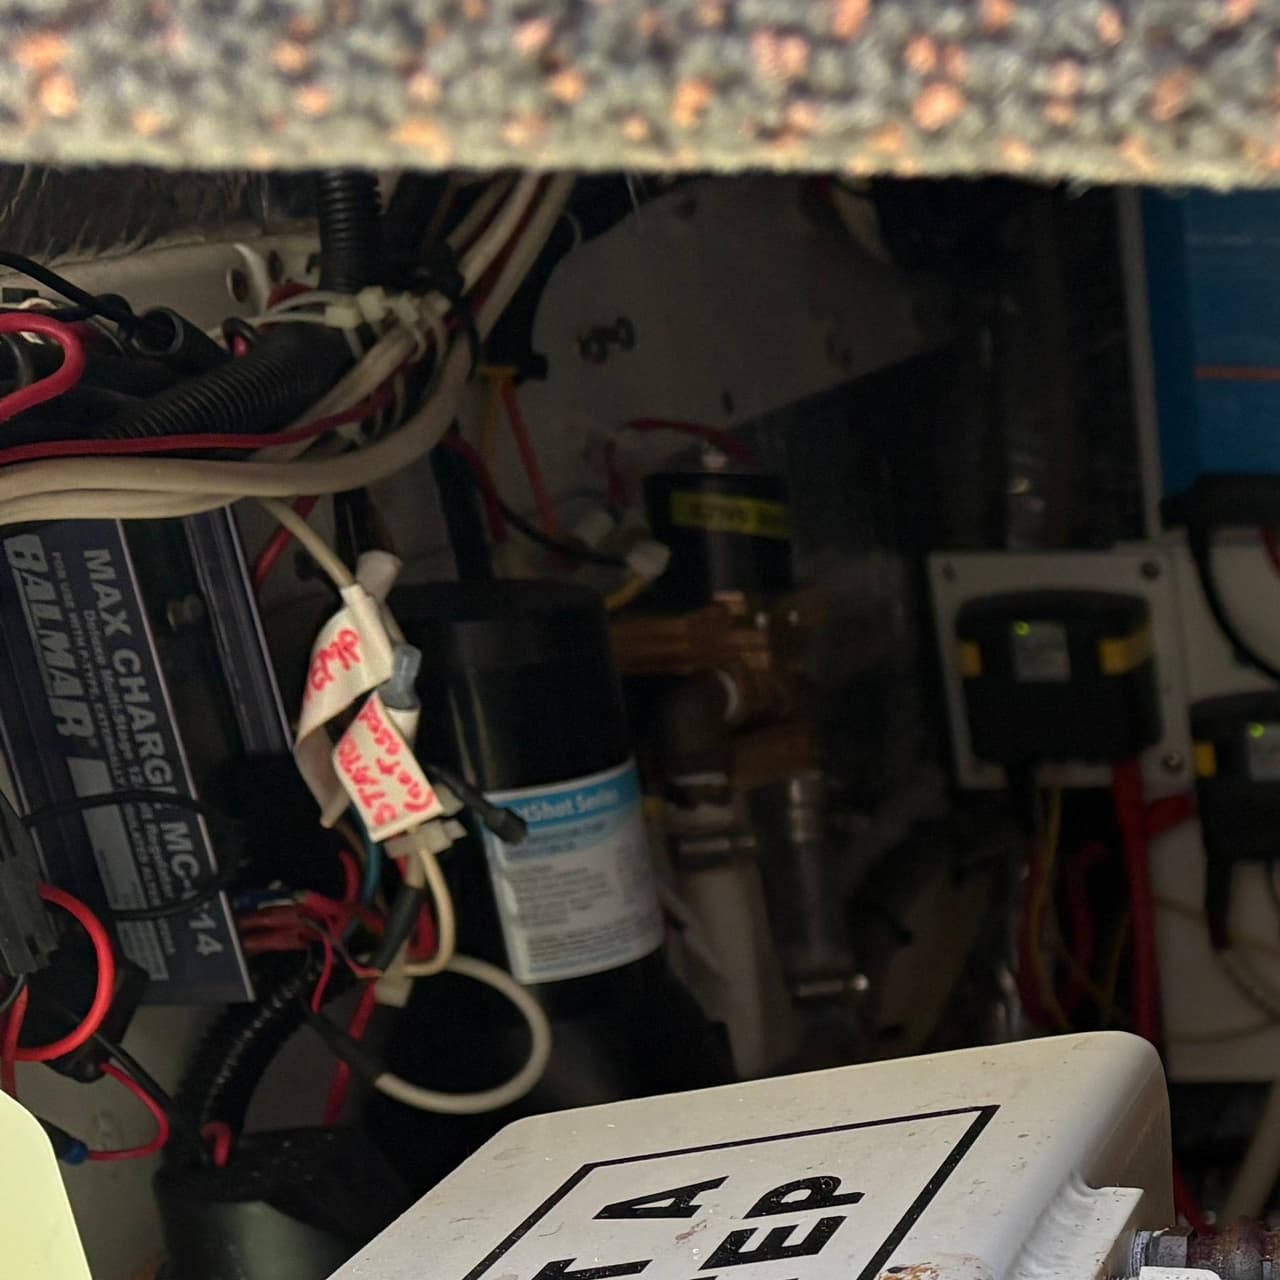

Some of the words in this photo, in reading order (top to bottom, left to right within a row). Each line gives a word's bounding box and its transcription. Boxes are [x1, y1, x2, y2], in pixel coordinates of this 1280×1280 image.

[4, 533, 96, 738] BALMAR
[83, 549, 132, 636] MAX
[160, 820, 223, 956] MC-14
[592, 1175, 731, 1221] A
